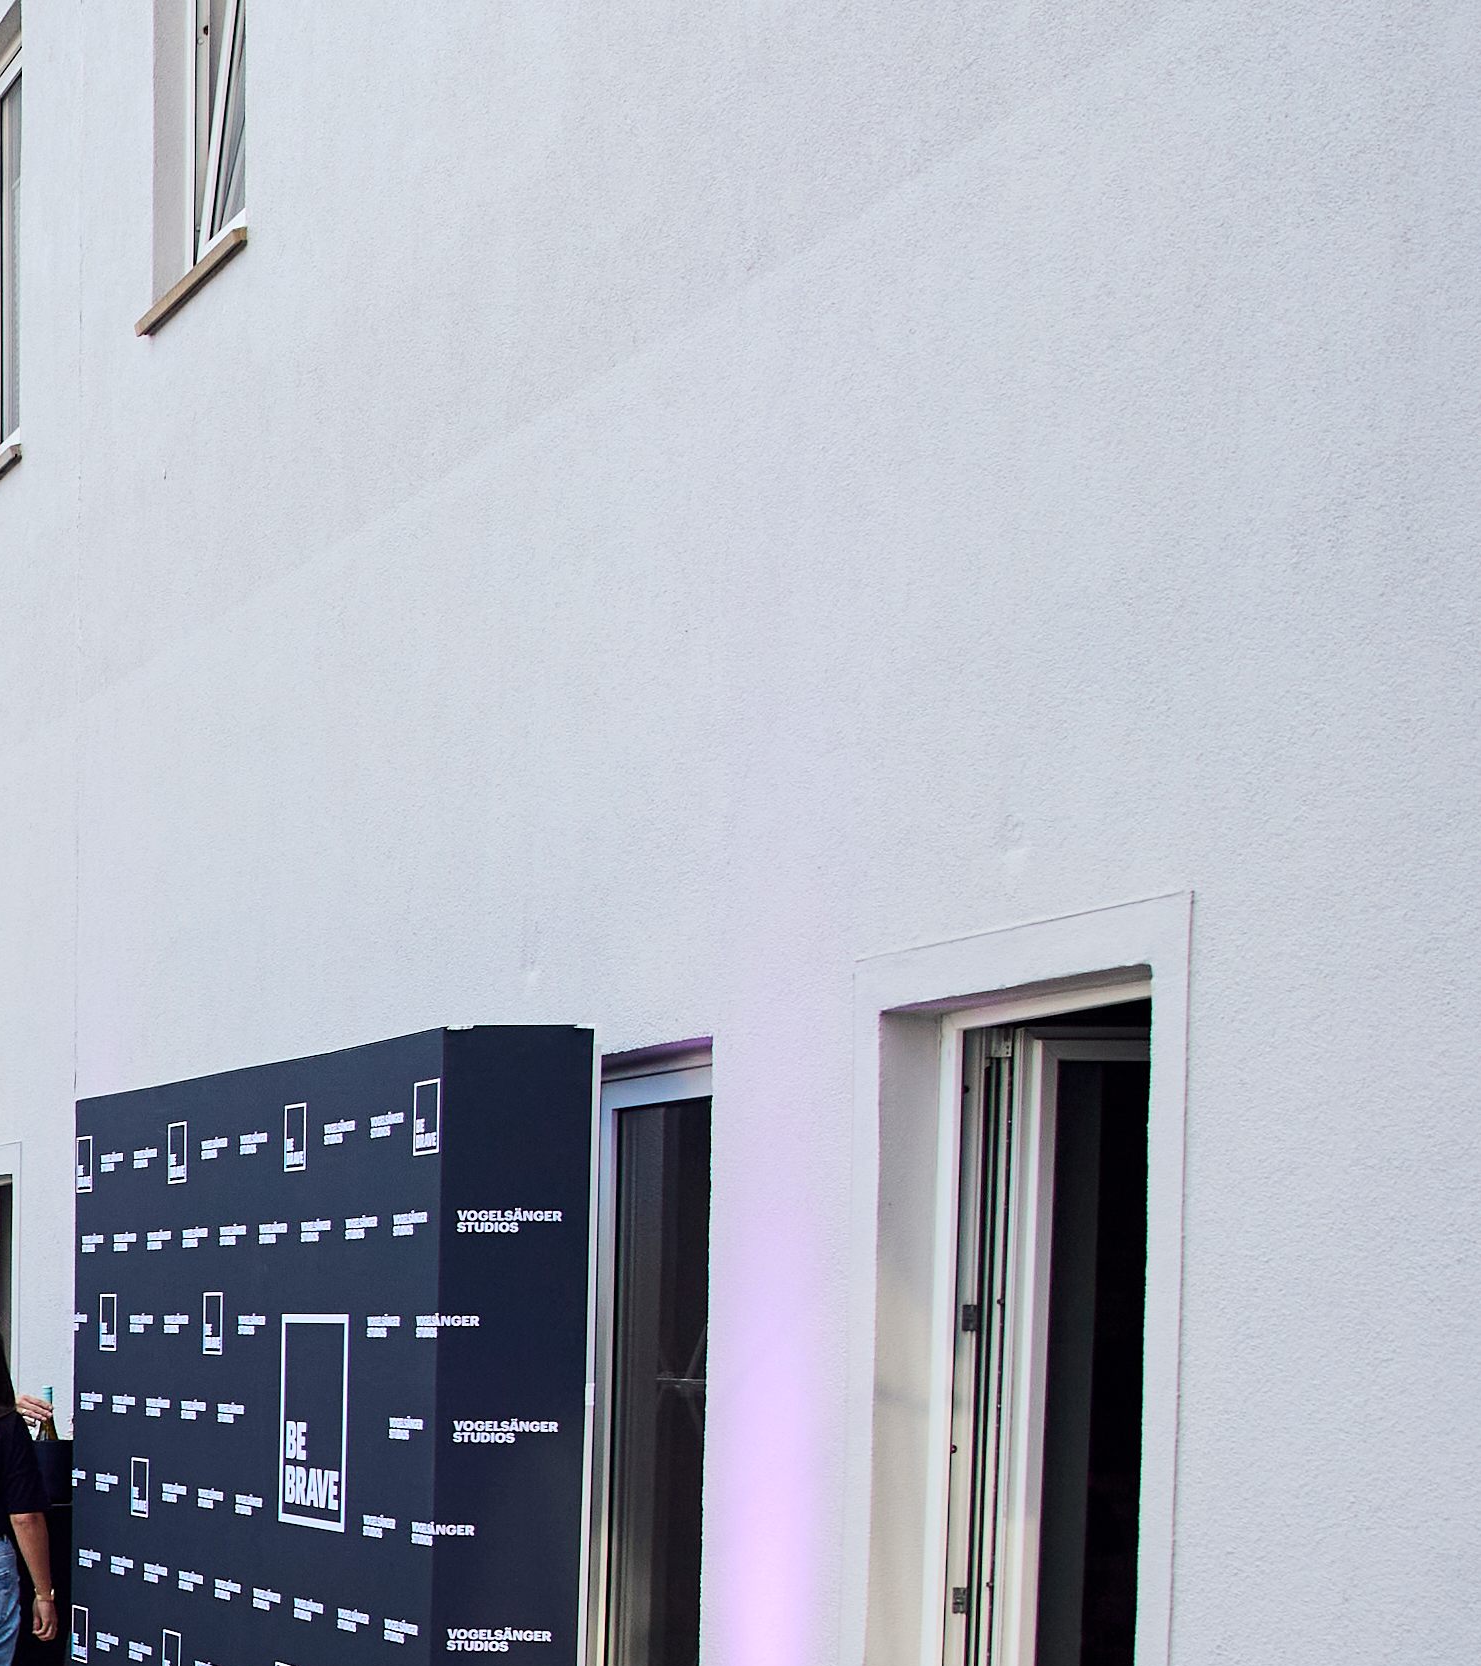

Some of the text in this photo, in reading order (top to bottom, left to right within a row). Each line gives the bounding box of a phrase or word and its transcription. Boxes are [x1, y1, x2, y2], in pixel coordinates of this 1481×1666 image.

[456, 1207, 563, 1222] VOGELSÄNGER
[456, 1221, 520, 1233] STUDIOS
[452, 1417, 559, 1433] VOGELSÄNGER
[285, 1420, 307, 1461] BE
[452, 1432, 516, 1444] STUDIOS
[284, 1464, 340, 1511] BRAVE
[446, 1626, 552, 1642] VOGELSÄNGER
[446, 1640, 509, 1652] STUDIOS
